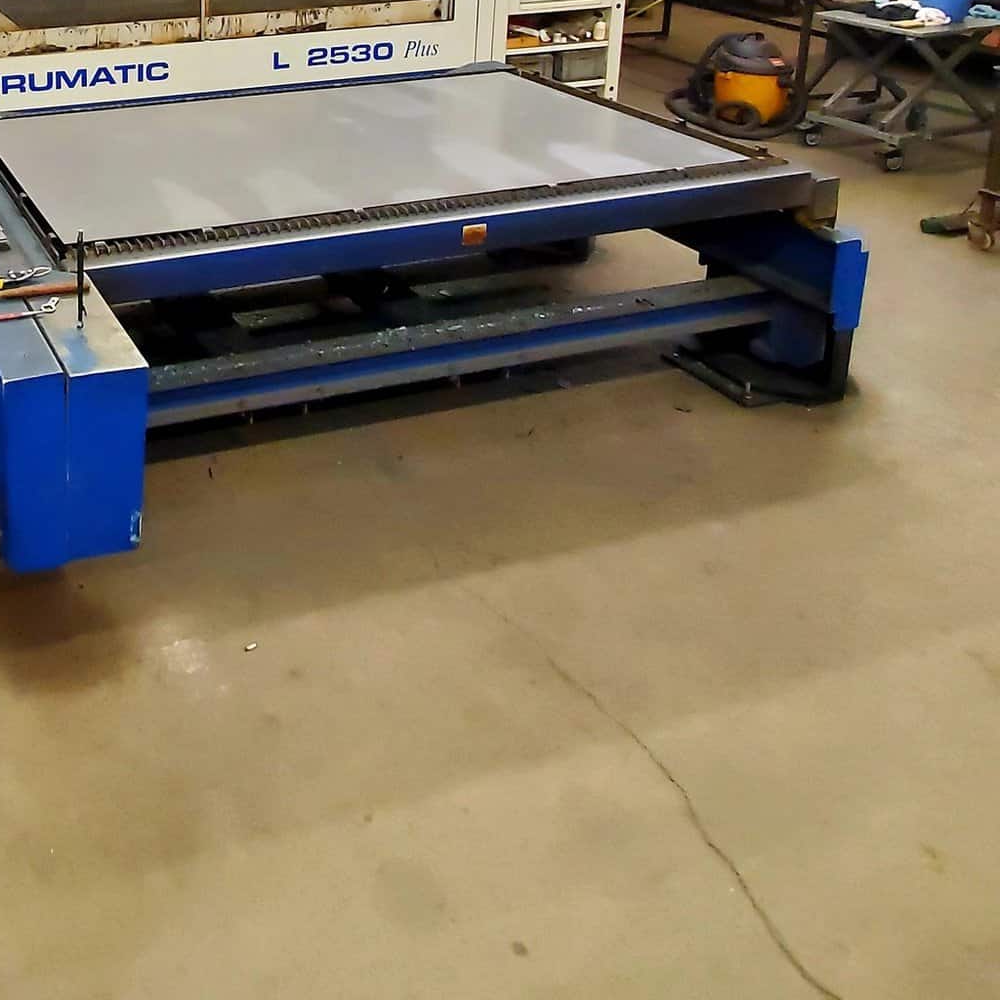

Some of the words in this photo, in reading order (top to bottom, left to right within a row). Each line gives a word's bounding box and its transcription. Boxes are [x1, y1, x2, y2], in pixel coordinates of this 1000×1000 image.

[273, 51, 290, 70] L
[307, 42, 394, 67] 2530
[404, 39, 440, 59] Plus
